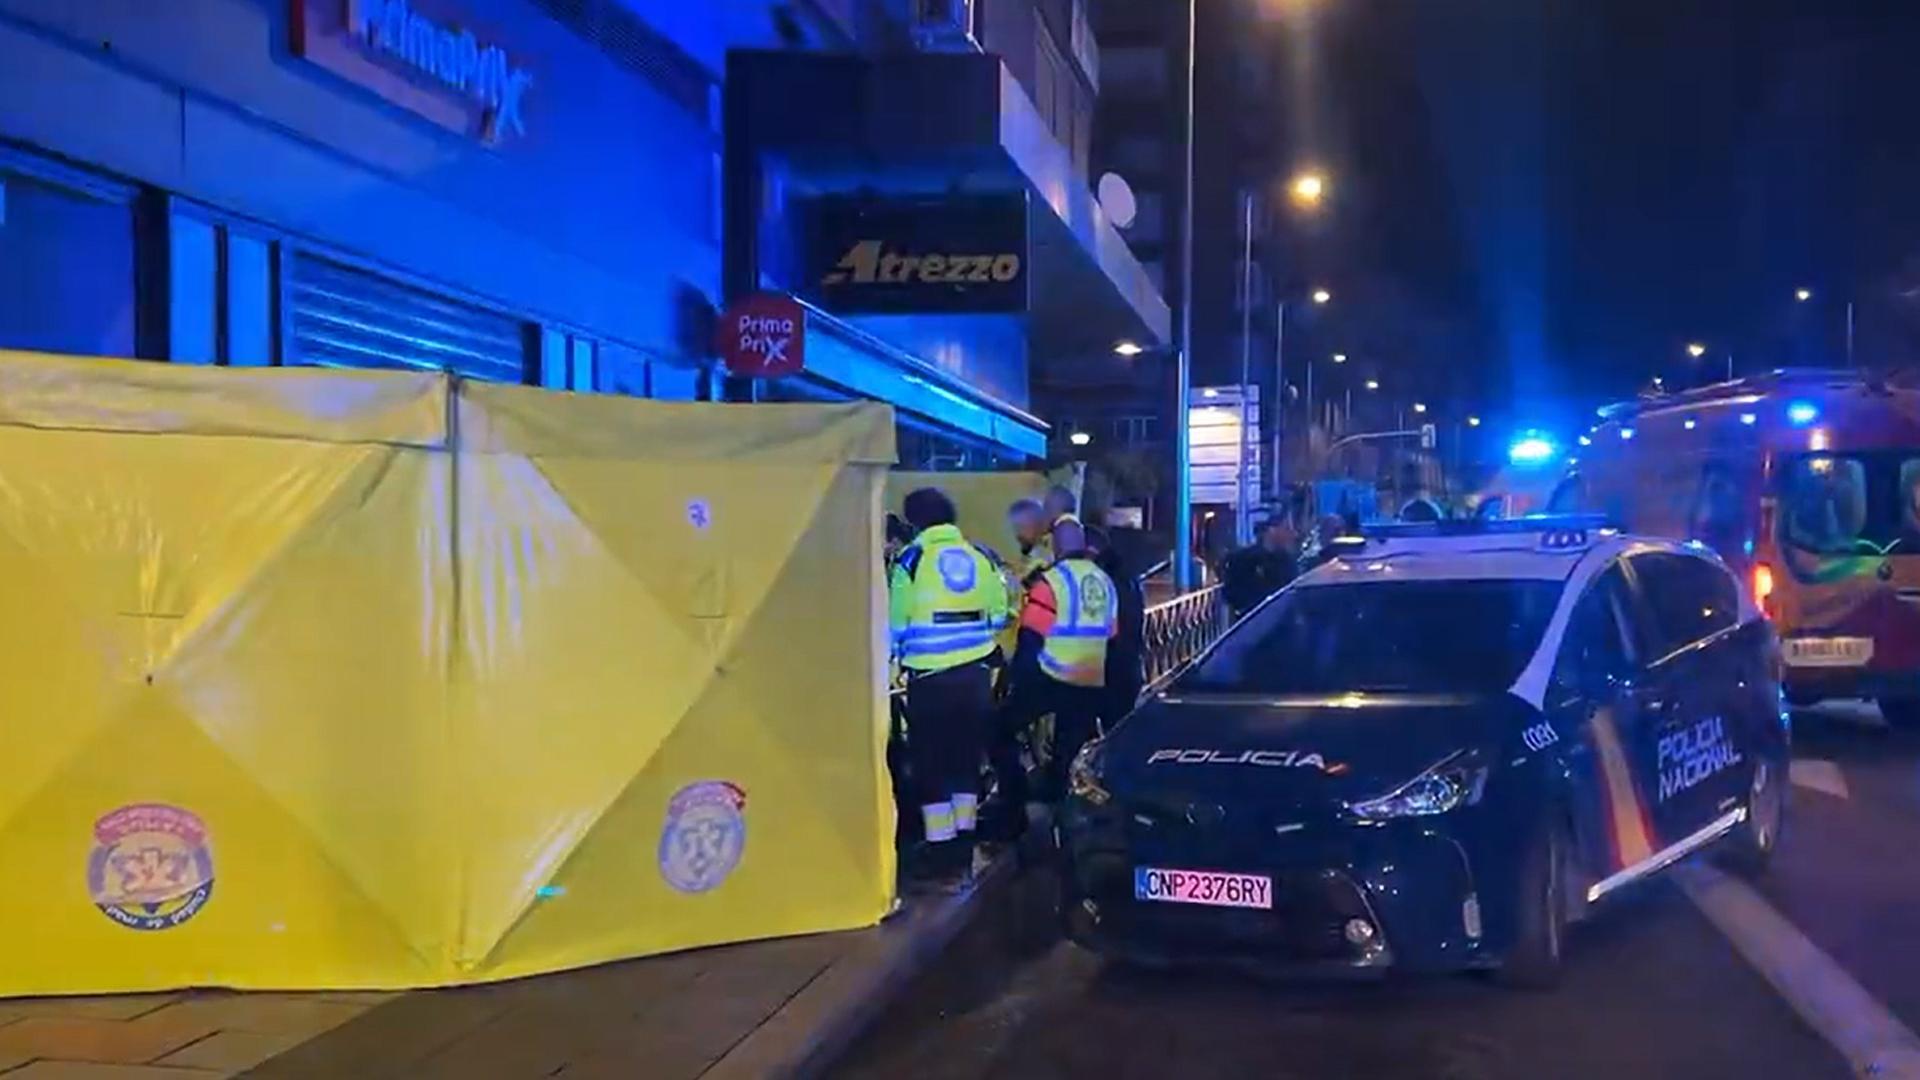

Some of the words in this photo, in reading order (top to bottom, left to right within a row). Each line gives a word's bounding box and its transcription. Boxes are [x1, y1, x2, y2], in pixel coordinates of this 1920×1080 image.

[822, 239, 1019, 285] Atrezzo
[739, 315, 793, 333] Prima
[1148, 749, 1325, 770] POLICIA
[1659, 740, 1741, 803] NACIONAL
[1147, 871, 1268, 904] CNP2376RY
